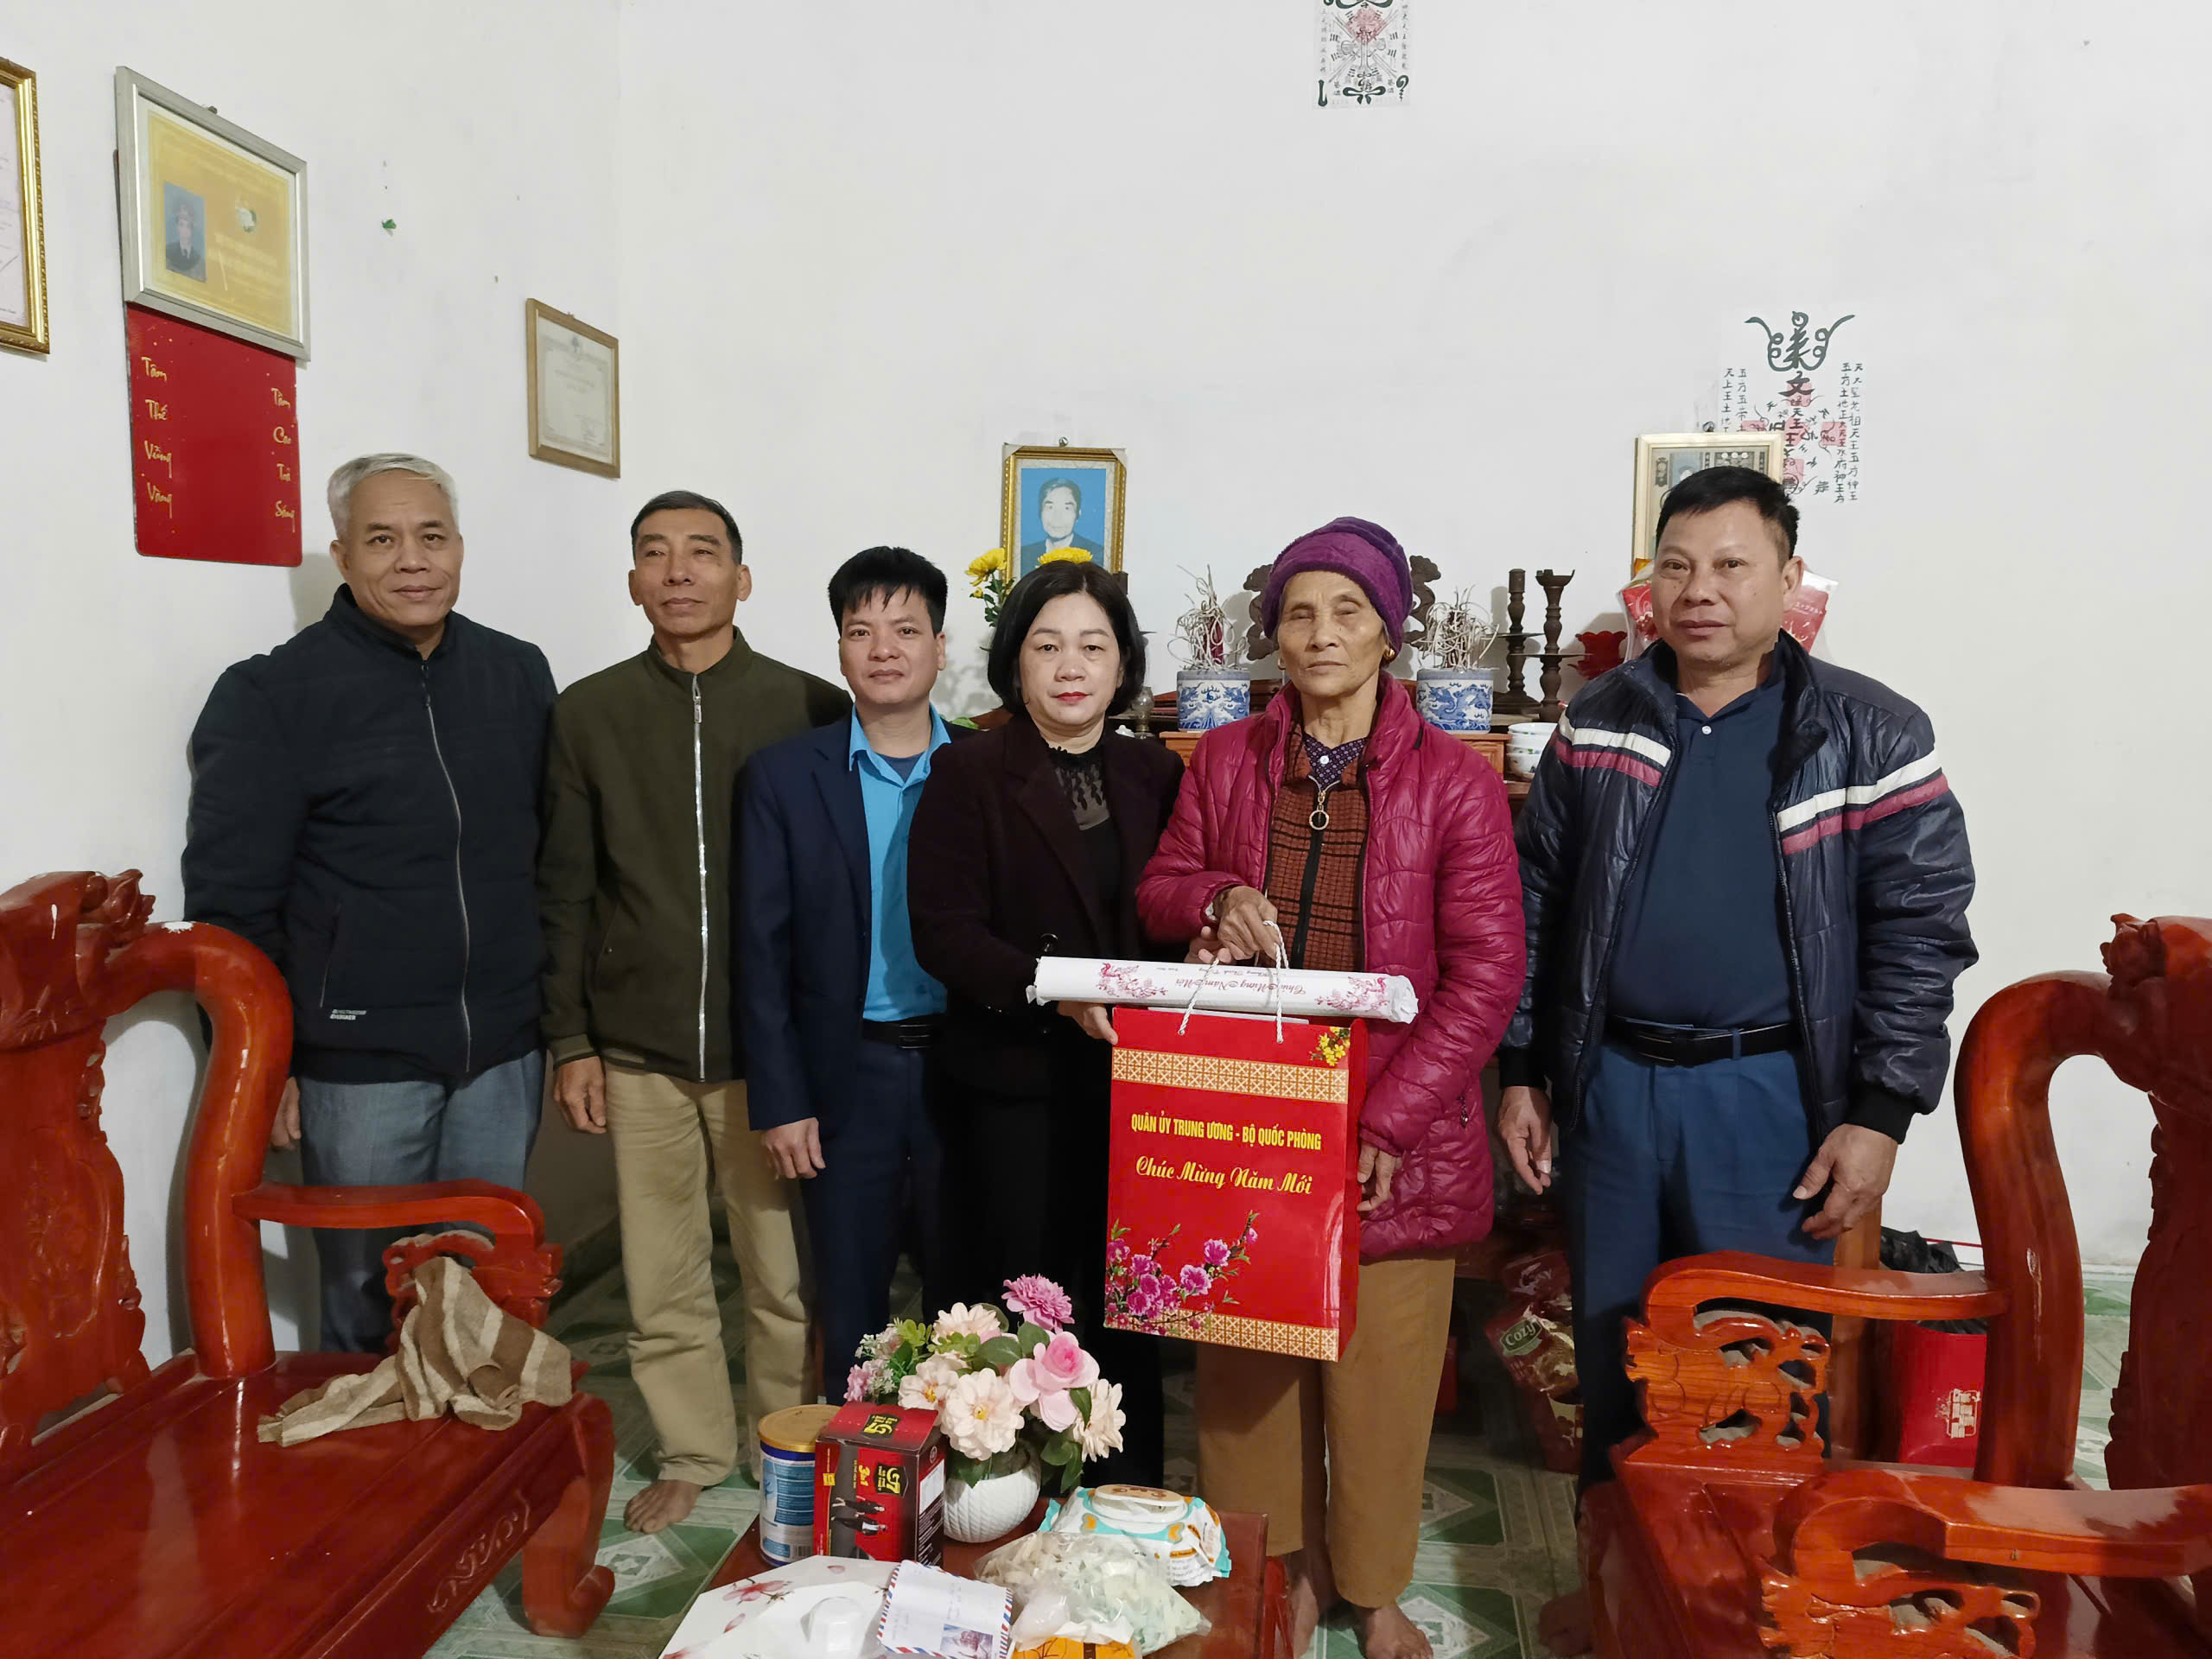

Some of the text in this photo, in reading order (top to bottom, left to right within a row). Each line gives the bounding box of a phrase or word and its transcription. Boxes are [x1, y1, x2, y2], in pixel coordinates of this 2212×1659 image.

[141, 357, 167, 382] Tâm
[145, 399, 168, 420] Thế
[1131, 1111, 1157, 1133] QUÂN
[1159, 1110, 1172, 1135] ỦY
[1173, 1118, 1205, 1138] TRUNG
[1206, 1121, 1233, 1141] ƯƠNG
[1242, 1124, 1256, 1147] BỘ
[1258, 1123, 1285, 1147] QUỐC
[1287, 1128, 1321, 1151] PHÒNG
[1135, 1155, 1313, 1194] Chúc Mừng Năm Mới
[1505, 1319, 1536, 1346] Cozy
[864, 1422, 893, 1435] G7
[886, 1467, 900, 1494] G7
